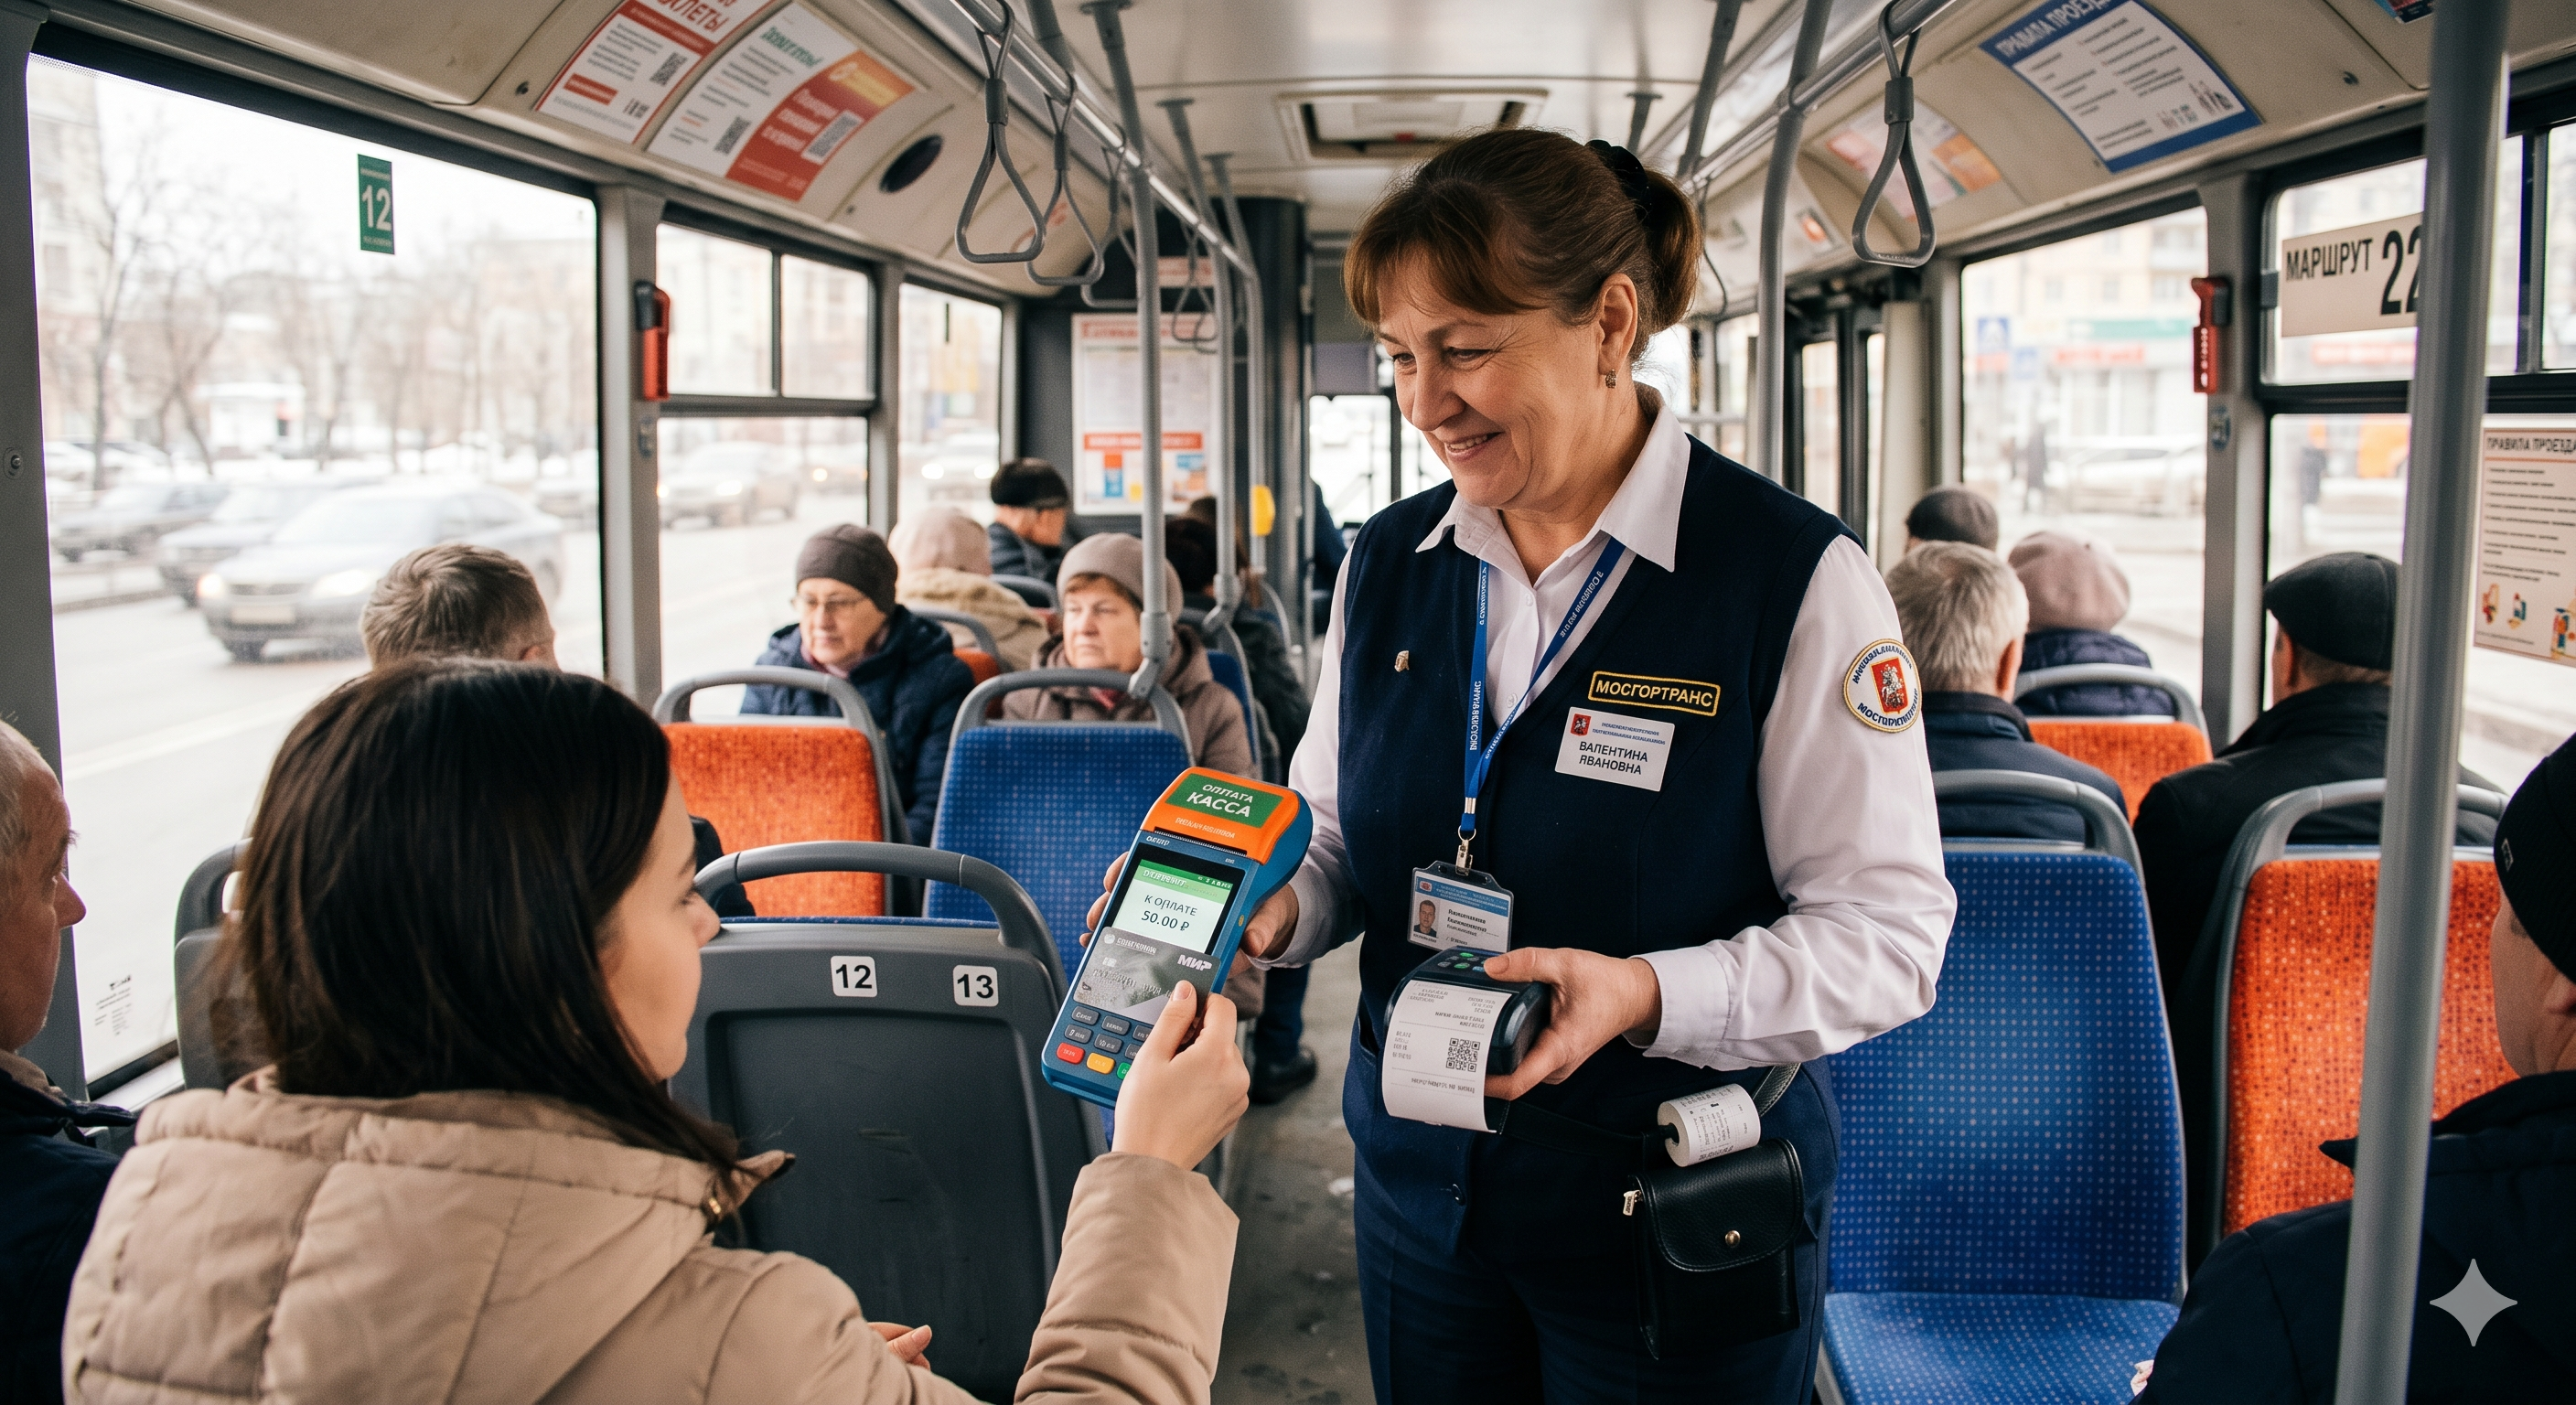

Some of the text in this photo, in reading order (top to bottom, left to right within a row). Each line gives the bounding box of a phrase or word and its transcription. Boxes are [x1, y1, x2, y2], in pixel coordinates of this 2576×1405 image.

[361, 184, 392, 231] 12
[2286, 238, 2373, 281] МАРШРУТ
[1595, 680, 1713, 707] МОСГОРТРАНС
[1186, 791, 1250, 818] КАССА
[1144, 895, 1154, 904] К
[1177, 954, 1213, 971] МИР
[835, 964, 873, 989] 12
[957, 973, 994, 999] 13
